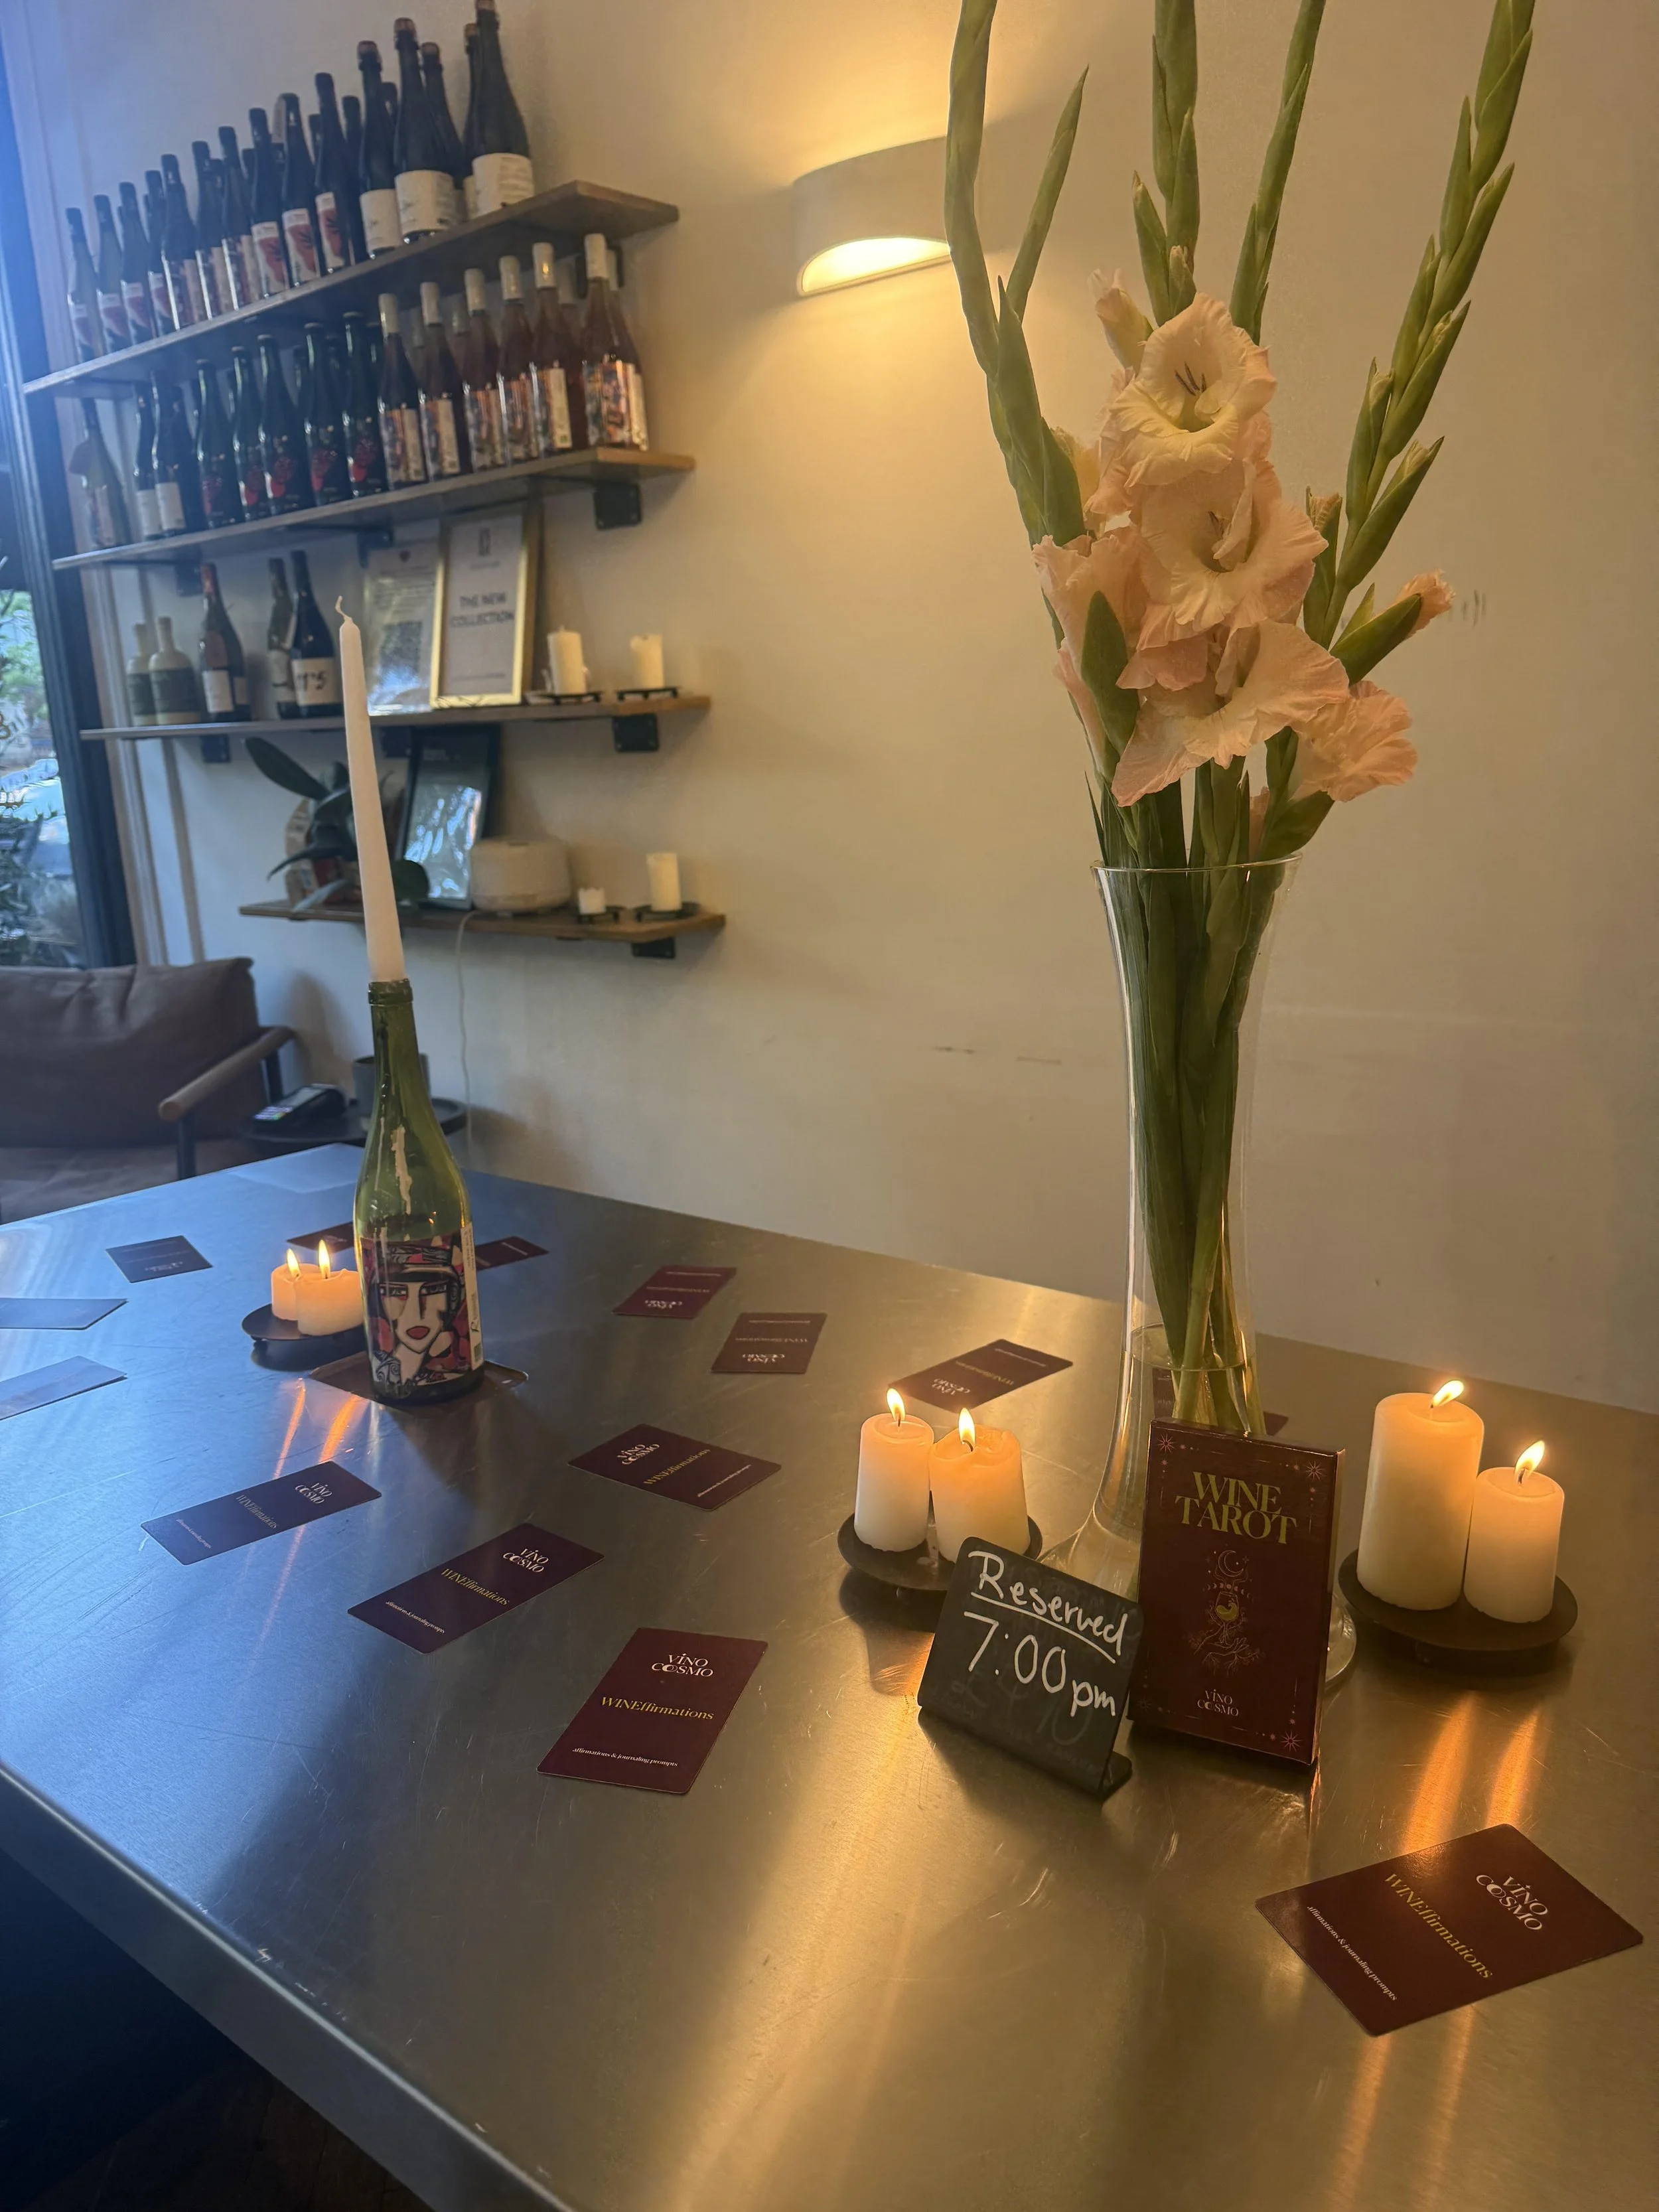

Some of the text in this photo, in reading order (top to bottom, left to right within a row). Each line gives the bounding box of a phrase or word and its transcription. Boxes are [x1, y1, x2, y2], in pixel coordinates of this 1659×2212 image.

[311, 1482, 333, 1497] VINO
[1192, 1471, 1282, 1514] WINE
[1175, 1495, 1297, 1545] TAROT
[502, 1552, 545, 1573] COSMO
[520, 1548, 549, 1564] VINO
[441, 1568, 510, 1606] WINEffirmations
[968, 1550, 1128, 1656] Reserved
[651, 1662, 714, 1677] COSMO
[668, 1653, 709, 1668] VINO
[601, 1696, 715, 1720] WINEffirmations
[1197, 1699, 1239, 1717] COSMO
[1204, 1688, 1233, 1705] VINO
[572, 1747, 611, 1758] affirmations
[617, 1753, 650, 1763] journaling
[649, 1759, 678, 1767] prompts
[1475, 1874, 1543, 1931] COSMO
[1502, 1876, 1548, 1915] VINO
[1384, 1873, 1493, 1979] WINEffirmations
[1307, 1905, 1340, 1940] affirmations
[1341, 1943, 1373, 1975] journaling
[1368, 1972, 1398, 2001] prompts
